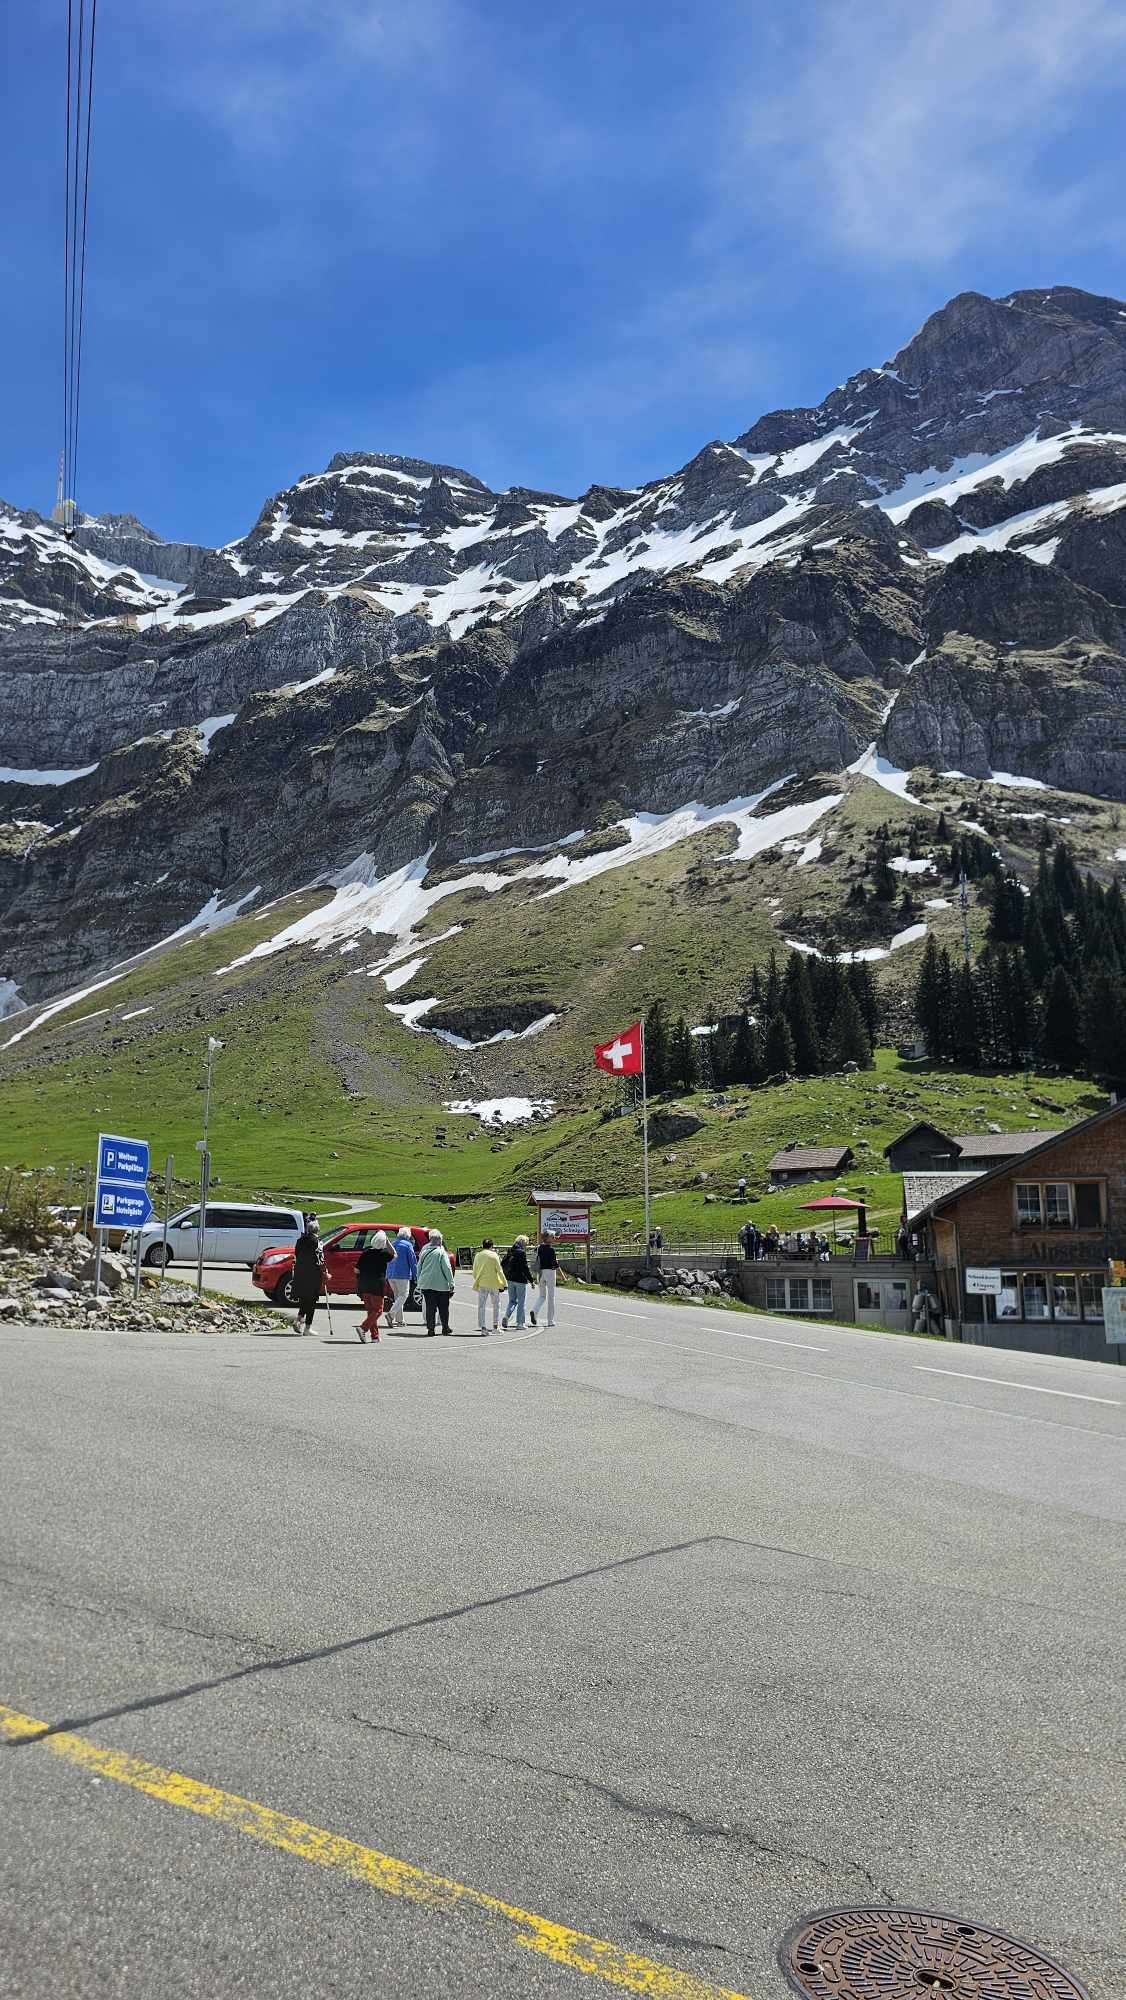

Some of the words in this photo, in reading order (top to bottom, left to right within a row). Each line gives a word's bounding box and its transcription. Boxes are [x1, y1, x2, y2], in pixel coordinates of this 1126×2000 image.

[118, 1152, 138, 1161] Weitere
[116, 1196, 144, 1207] Parkgarage
[116, 1206, 142, 1216] Hotelgäste
